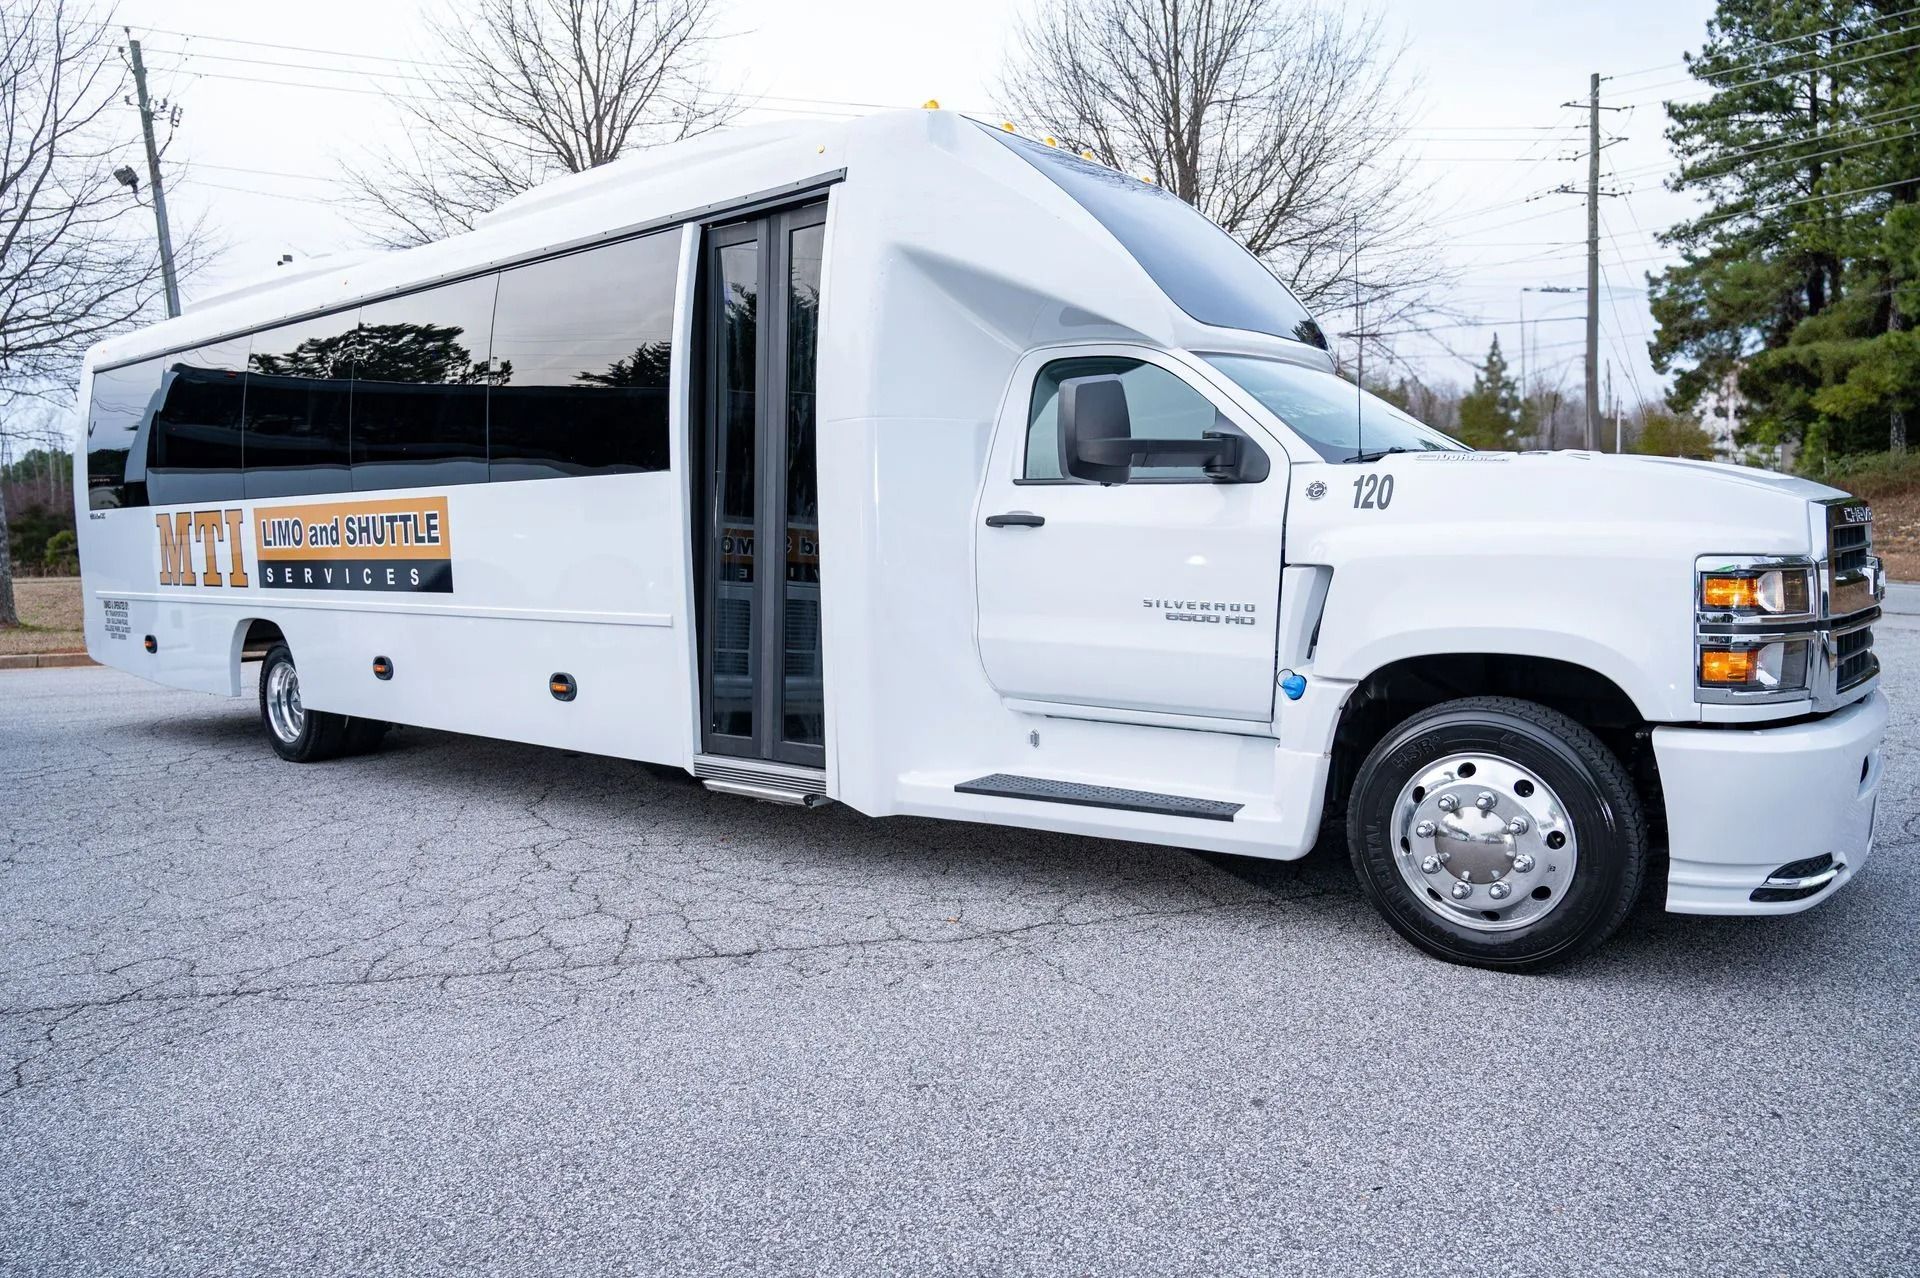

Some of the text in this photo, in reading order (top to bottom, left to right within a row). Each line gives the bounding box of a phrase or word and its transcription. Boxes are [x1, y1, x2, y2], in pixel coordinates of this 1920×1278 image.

[1353, 474, 1394, 510] 120
[1843, 506, 1874, 523] CHEVR
[260, 511, 441, 549] LIMO and SHUTTLE
[156, 508, 249, 588] MTI
[266, 567, 420, 586] SERVICES
[1143, 599, 1256, 613] SILVERADO
[1225, 614, 1256, 626] HD
